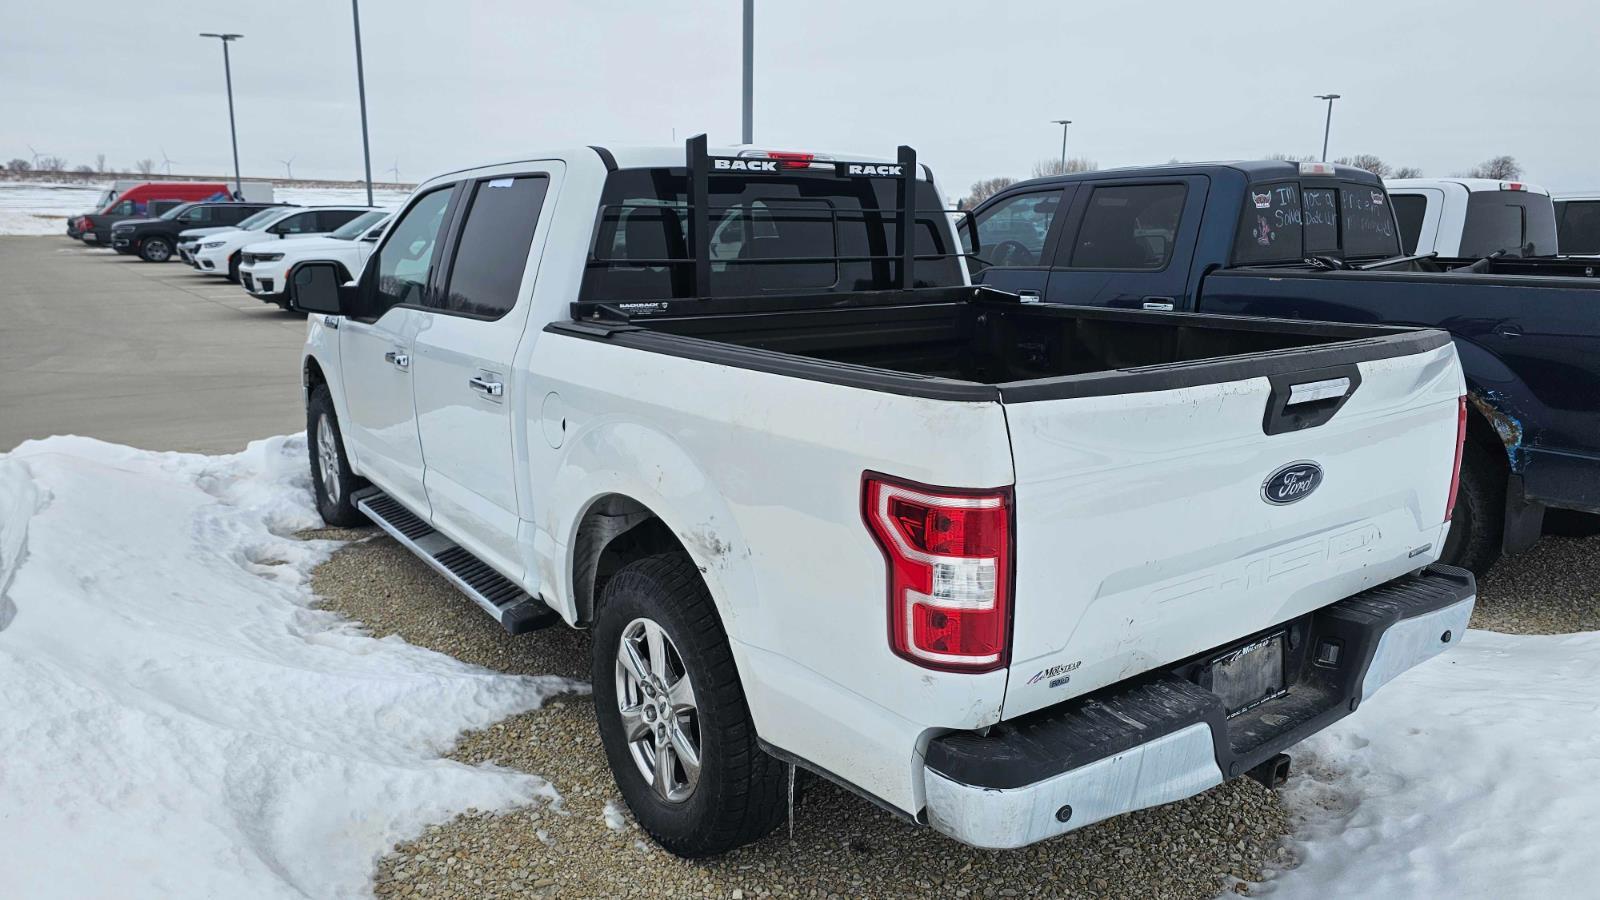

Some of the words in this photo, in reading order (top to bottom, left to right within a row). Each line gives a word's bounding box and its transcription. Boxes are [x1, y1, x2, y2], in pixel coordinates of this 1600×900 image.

[714, 159, 777, 171] BACK
[849, 164, 903, 175] RACK
[1278, 470, 1314, 498] Ford
